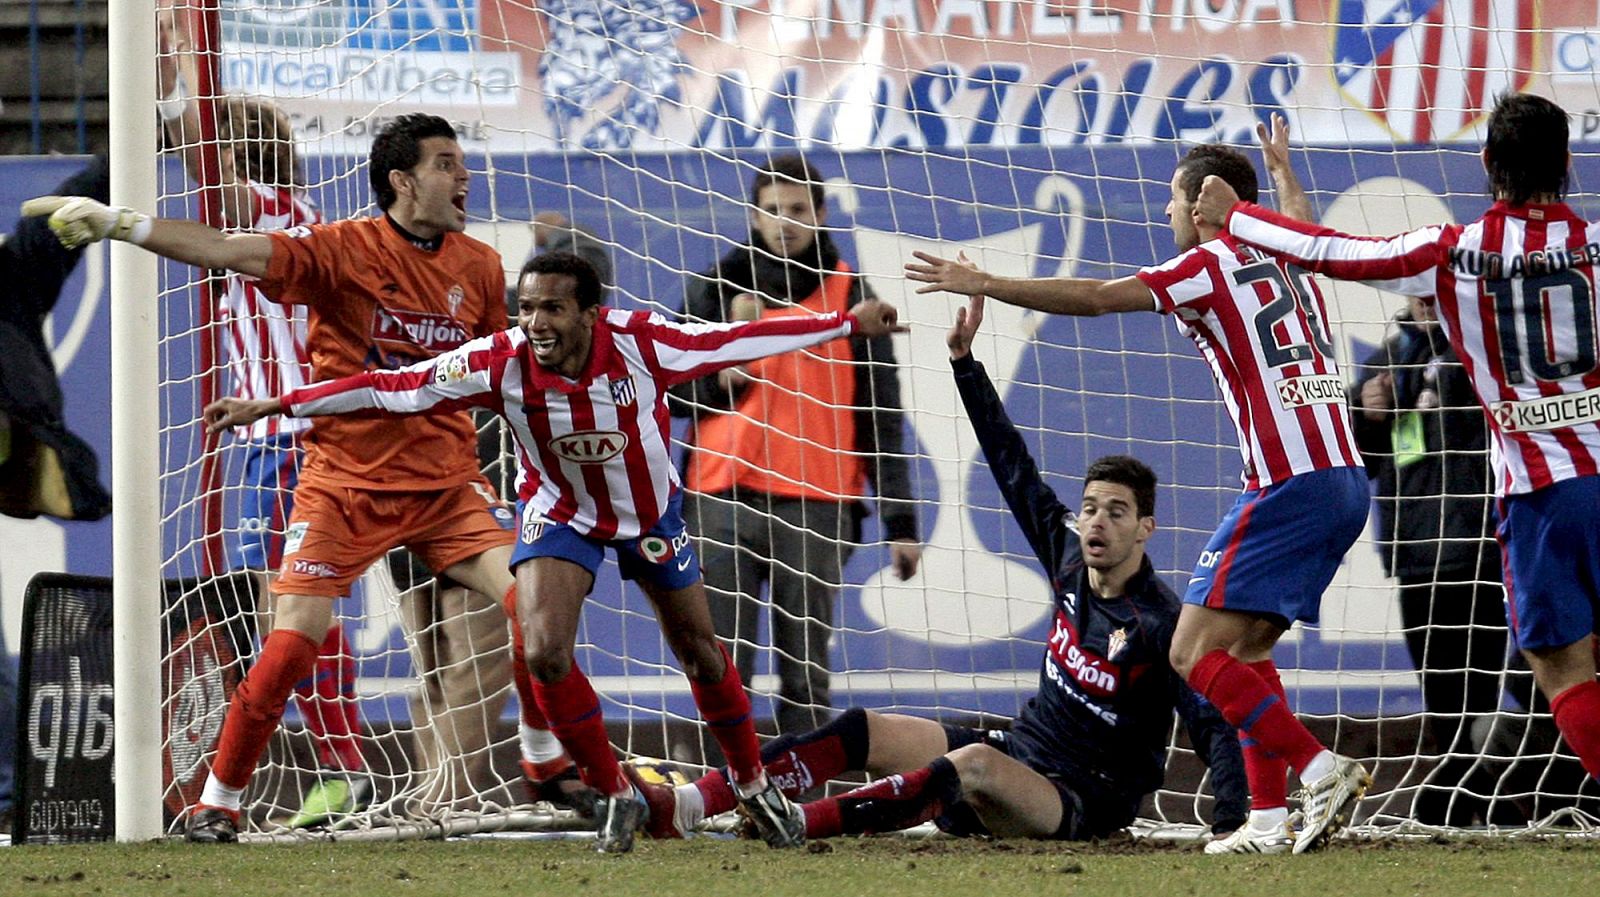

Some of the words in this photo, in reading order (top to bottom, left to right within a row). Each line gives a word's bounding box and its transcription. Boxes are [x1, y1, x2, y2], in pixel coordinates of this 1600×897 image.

[1232, 262, 1335, 368] 20
[1484, 268, 1597, 387] 10
[559, 437, 617, 456] KIA
